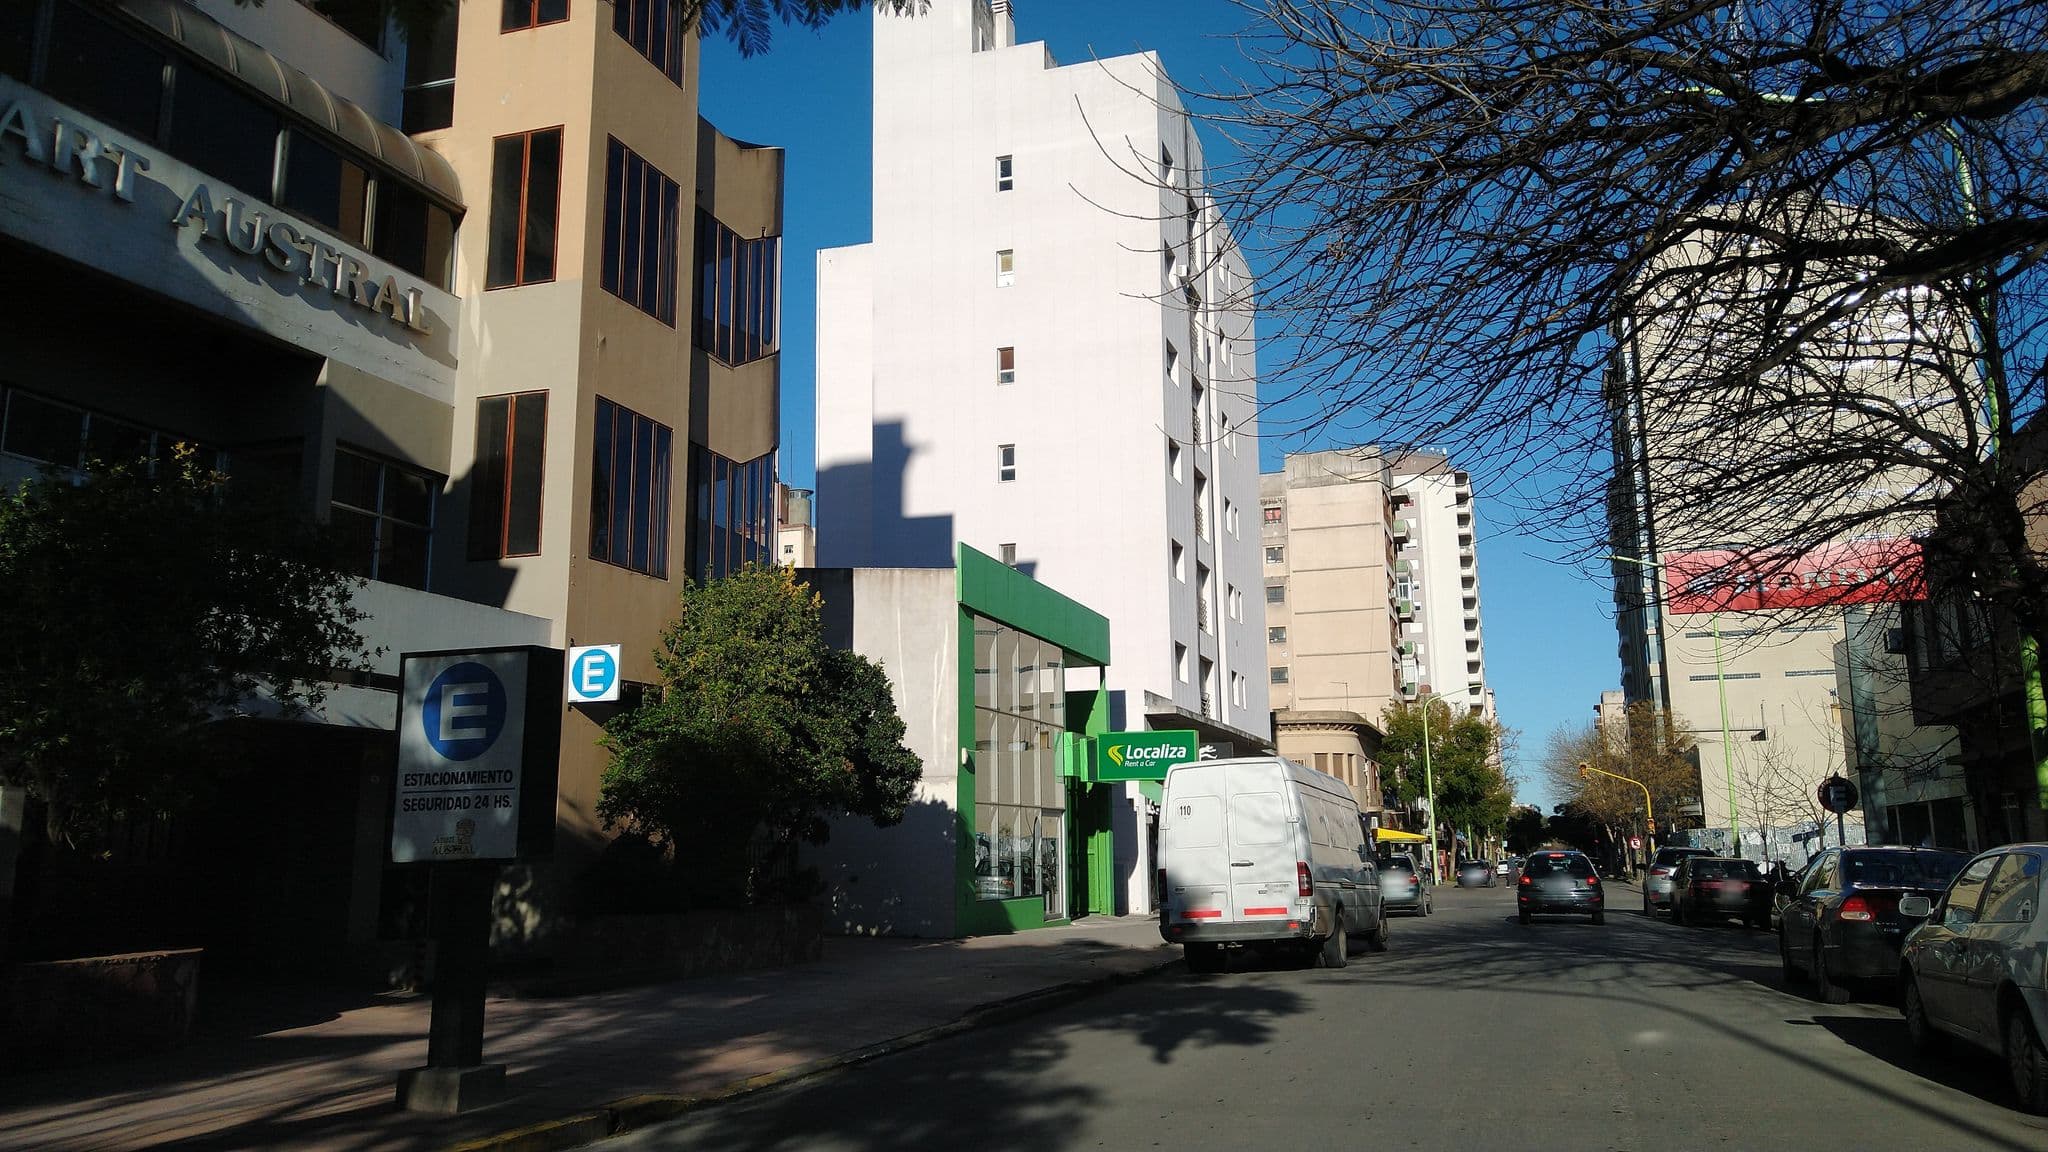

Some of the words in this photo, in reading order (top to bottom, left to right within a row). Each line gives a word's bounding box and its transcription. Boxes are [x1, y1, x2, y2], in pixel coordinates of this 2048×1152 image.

[173, 184, 433, 335] AUSTRAL
[581, 654, 606, 692] E
[439, 682, 489, 740] E
[1127, 744, 1187, 759] Localiza
[404, 770, 513, 786] ESTACIONAMIENTO
[403, 796, 471, 811] SEGURIDAD
[475, 796, 489, 809] 24
[493, 795, 513, 808] HS.
[1180, 805, 1192, 816] 110
